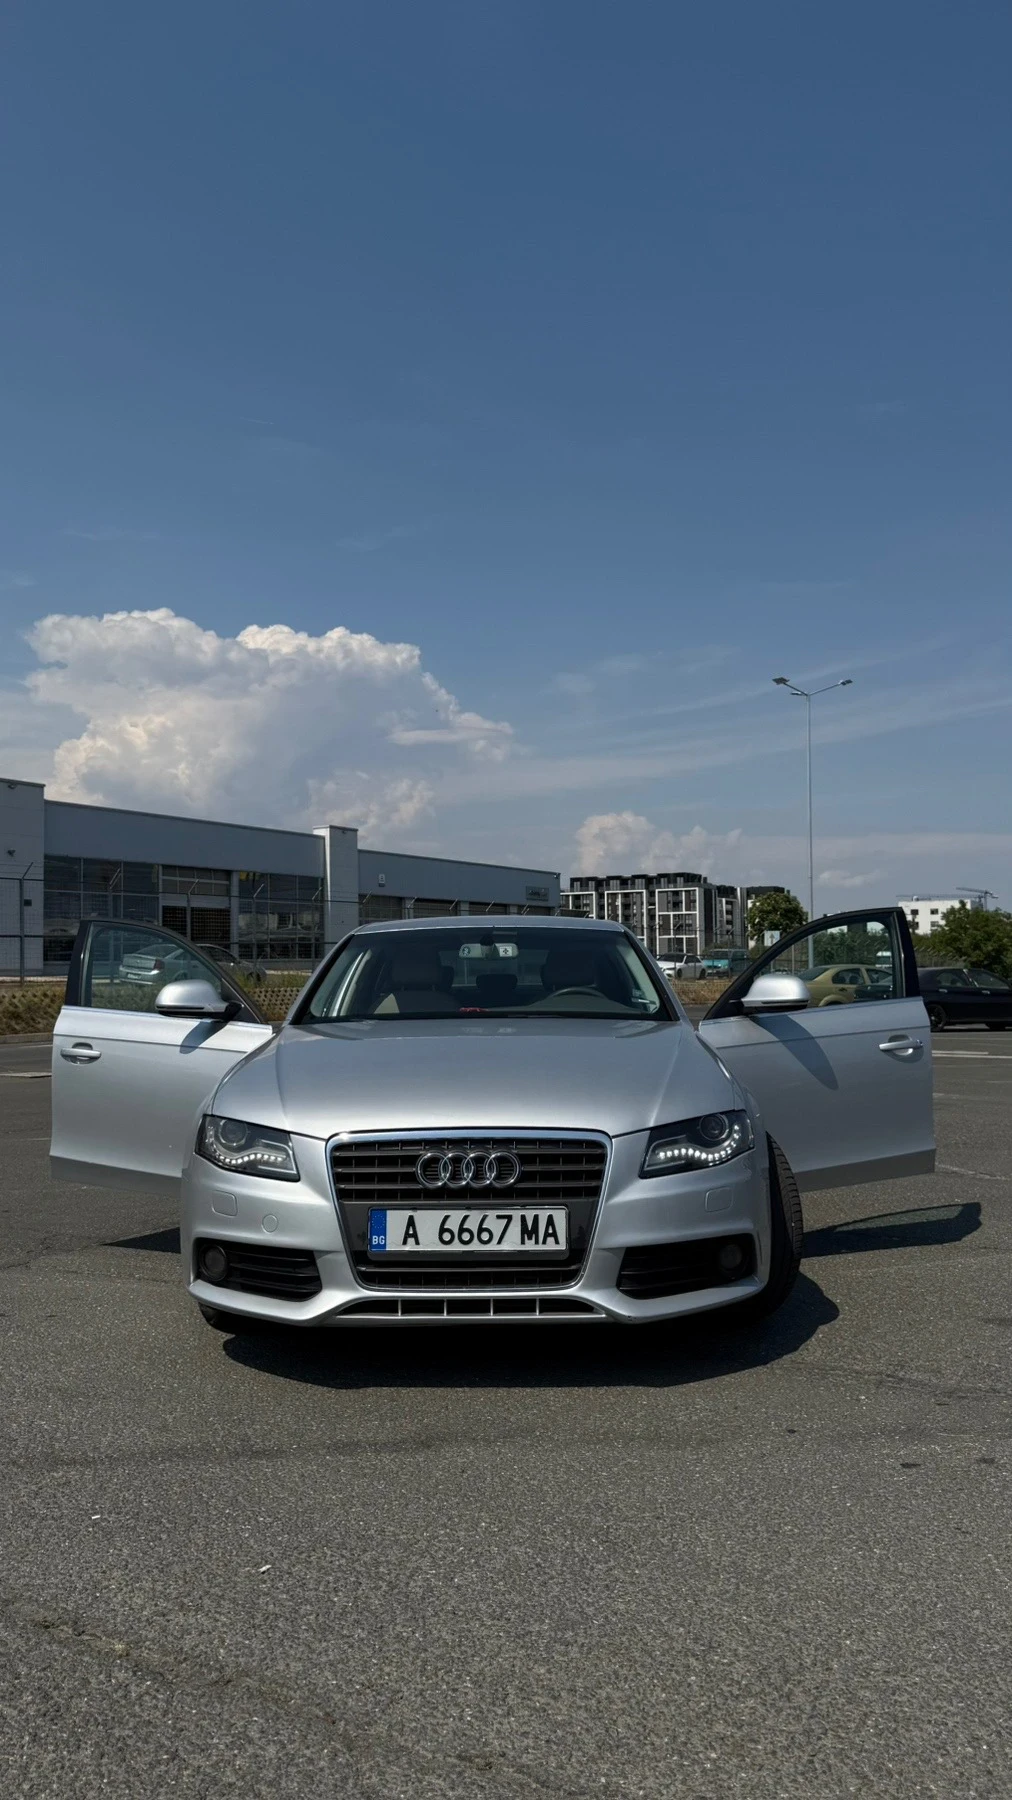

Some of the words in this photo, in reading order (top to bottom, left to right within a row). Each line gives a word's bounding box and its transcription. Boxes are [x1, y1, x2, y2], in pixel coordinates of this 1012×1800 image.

[402, 1214, 420, 1245] A
[438, 1214, 513, 1245] 6667
[520, 1214, 560, 1245] MA
[372, 1235, 385, 1245] BG
